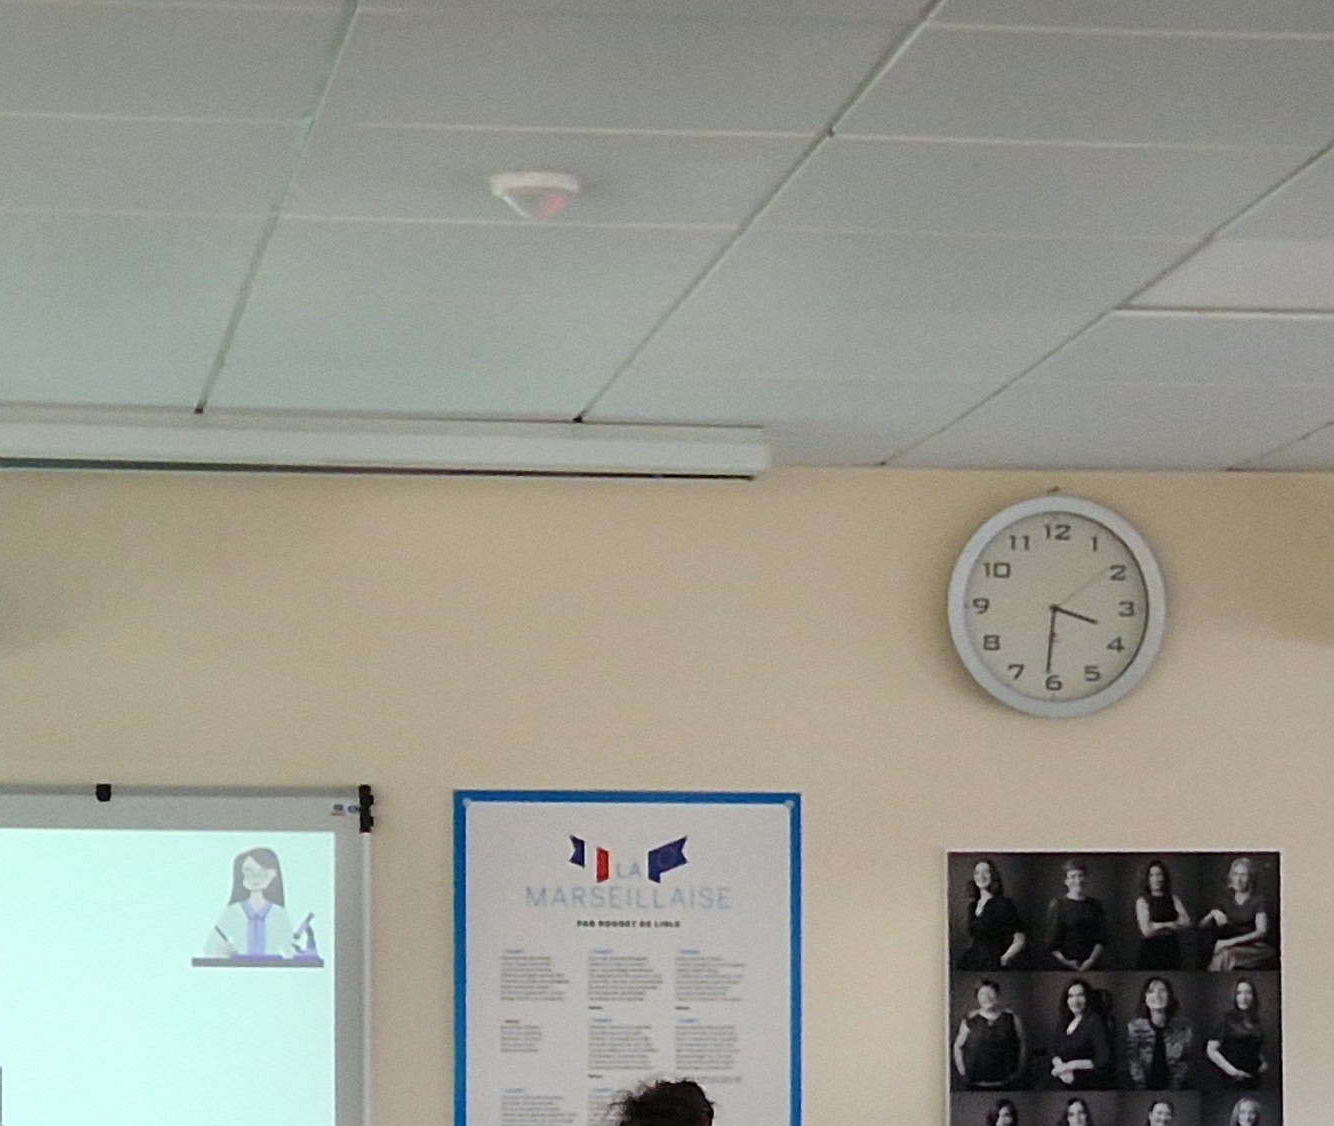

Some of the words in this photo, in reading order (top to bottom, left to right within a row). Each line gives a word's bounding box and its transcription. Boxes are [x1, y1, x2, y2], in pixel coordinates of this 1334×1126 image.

[1044, 523, 1071, 541] 12
[1010, 535, 1030, 551] 11
[1091, 536, 1098, 551] 1
[983, 562, 1011, 578] 10
[1110, 564, 1126, 581] 2
[973, 597, 990, 614] 9
[1118, 601, 1135, 617] 3
[983, 634, 1001, 651] 8
[1106, 637, 1125, 653] 4
[1008, 664, 1025, 680] 7
[1084, 665, 1101, 682] 5
[1045, 675, 1063, 691] 6
[617, 862, 642, 879] LA
[526, 886, 731, 909] MARSEILLAISE
